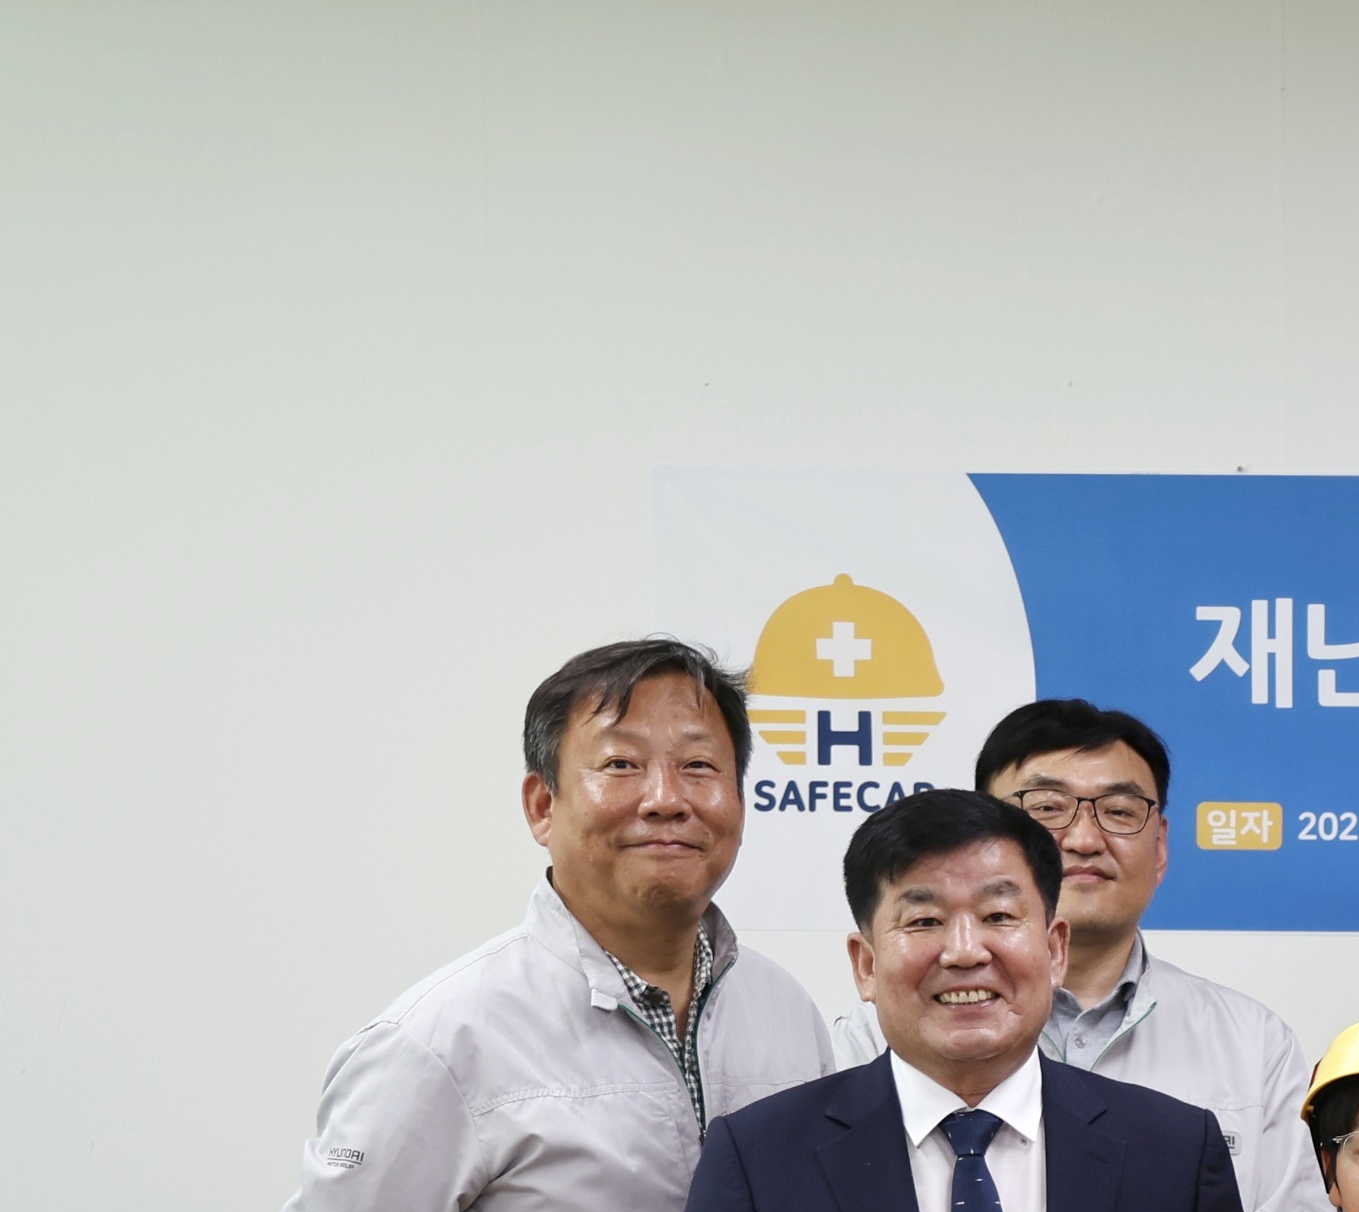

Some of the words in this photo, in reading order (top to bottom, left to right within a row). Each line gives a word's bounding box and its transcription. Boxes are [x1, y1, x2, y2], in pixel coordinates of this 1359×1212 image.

[817, 710, 872, 766] H
[754, 780, 935, 812] SAFECA
[1206, 809, 1274, 845] 일자
